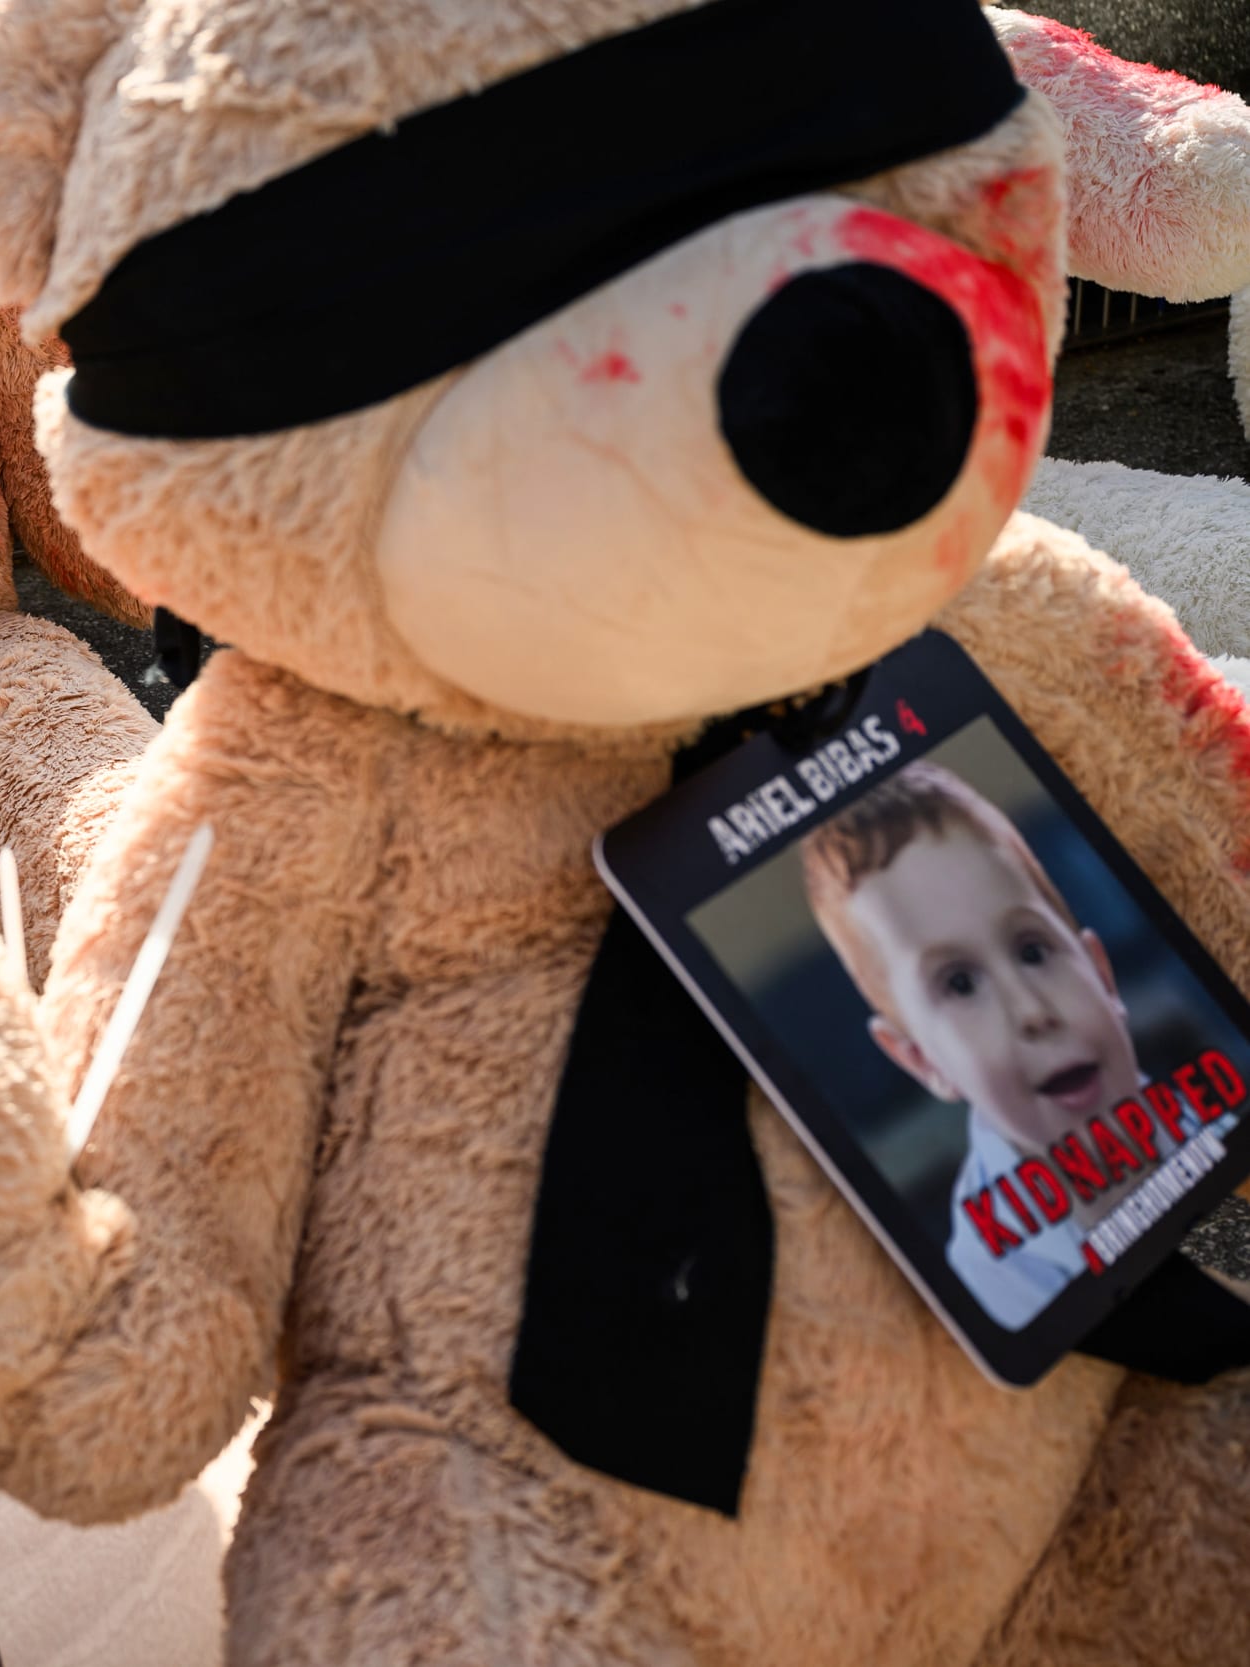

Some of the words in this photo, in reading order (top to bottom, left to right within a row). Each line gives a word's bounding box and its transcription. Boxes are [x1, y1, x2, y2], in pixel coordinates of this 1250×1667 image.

[707, 774, 817, 866] ARIEL
[795, 715, 900, 802] BIBAS
[895, 698, 928, 736] 4
[961, 1049, 1248, 1259] KIDNAPPED
